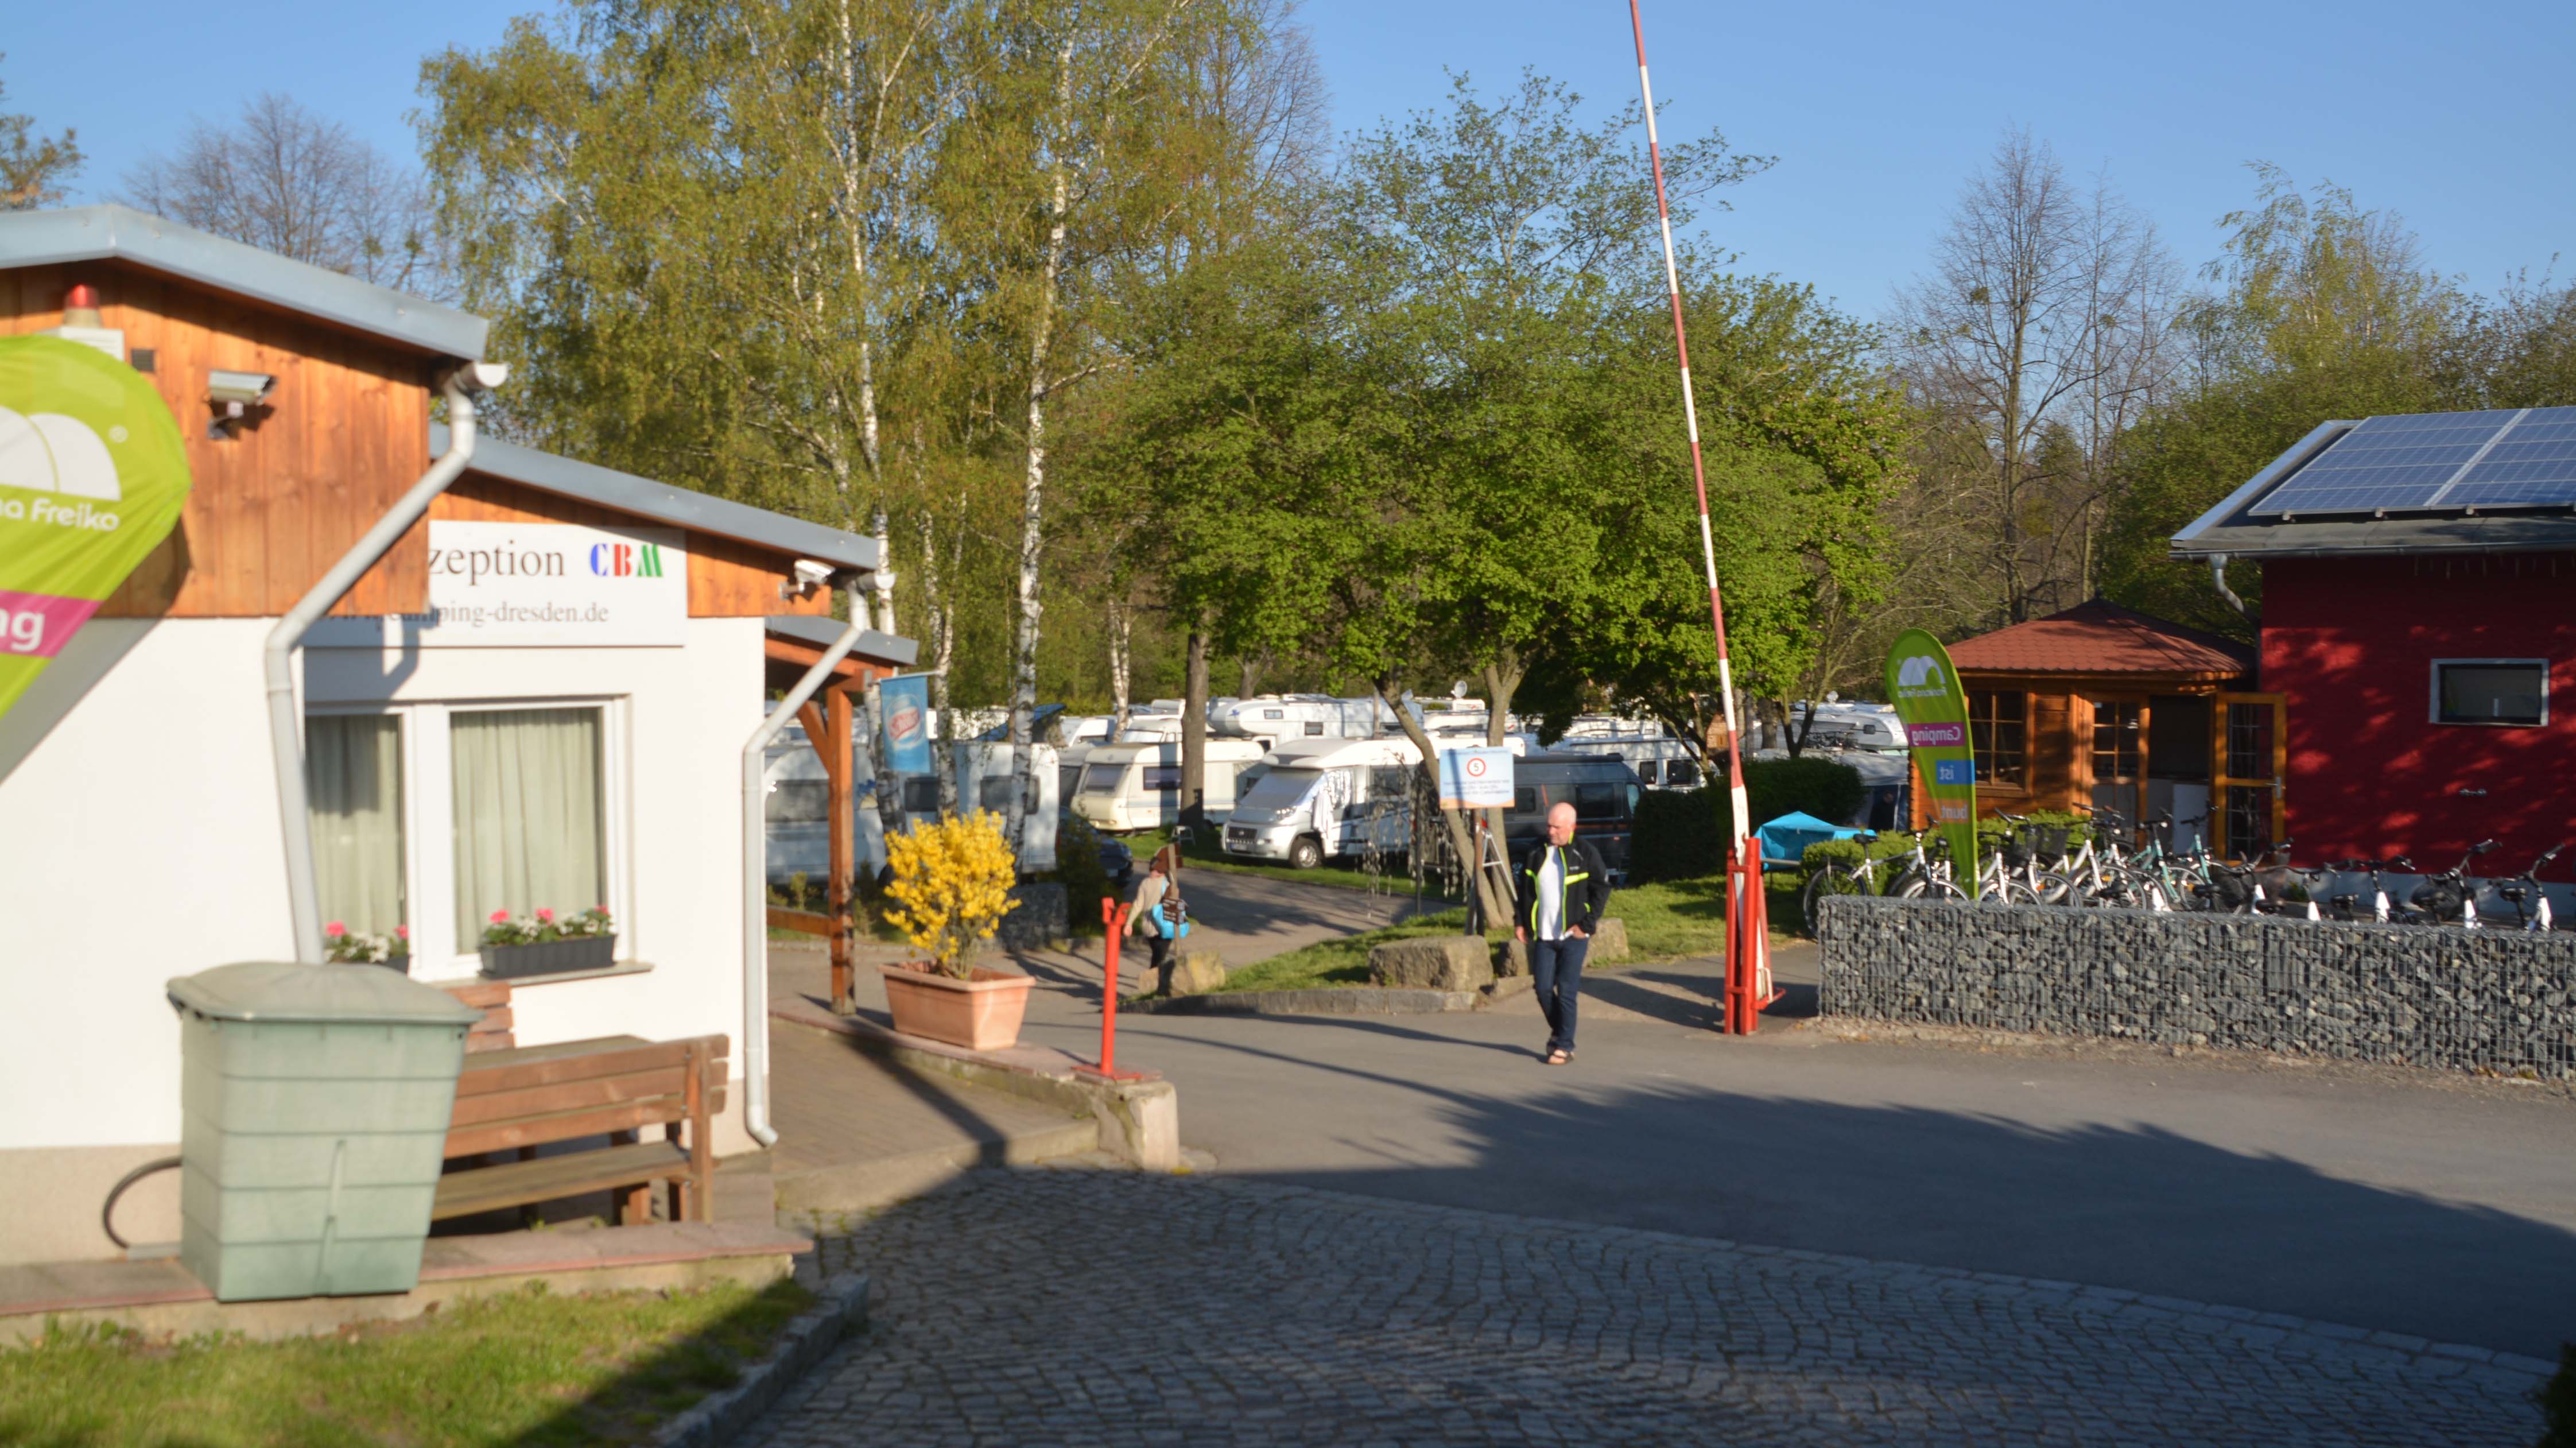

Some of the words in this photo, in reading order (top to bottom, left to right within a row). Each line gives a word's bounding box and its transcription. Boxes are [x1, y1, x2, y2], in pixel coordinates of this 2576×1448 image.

[31, 497, 119, 532] Freiko
[428, 540, 565, 586] zeption
[589, 543, 664, 577] CBM
[1473, 762, 1480, 772] 5
